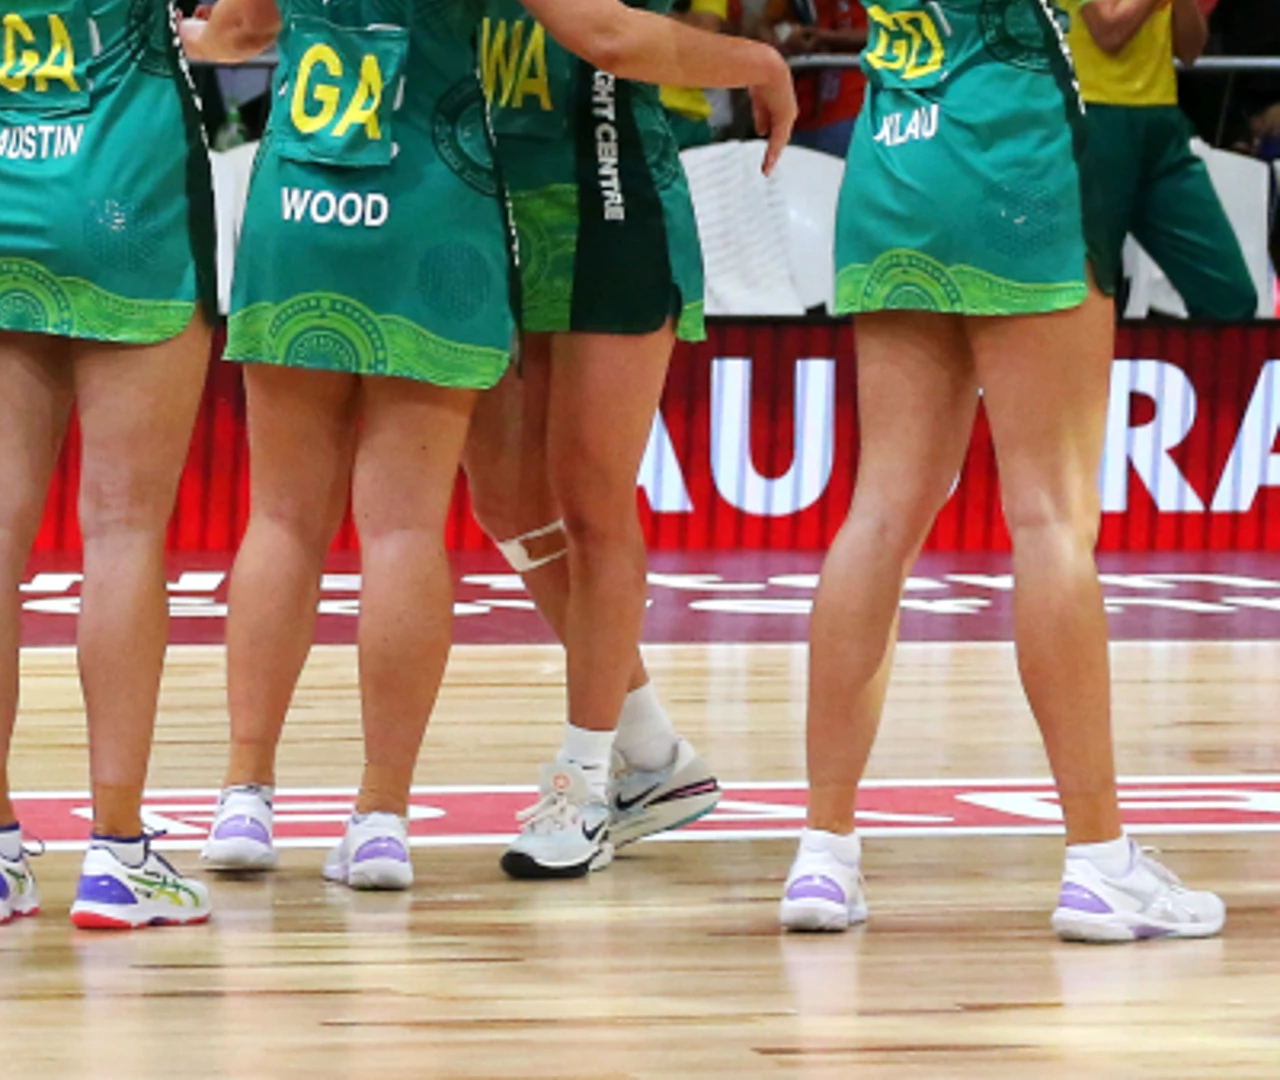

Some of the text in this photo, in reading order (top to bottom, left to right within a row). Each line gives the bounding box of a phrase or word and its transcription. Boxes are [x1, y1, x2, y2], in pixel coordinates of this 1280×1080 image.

[291, 43, 382, 139] GA
[482, 17, 553, 111] WA
[281, 186, 389, 227] WOOD
[595, 123, 625, 220] CENTRE
